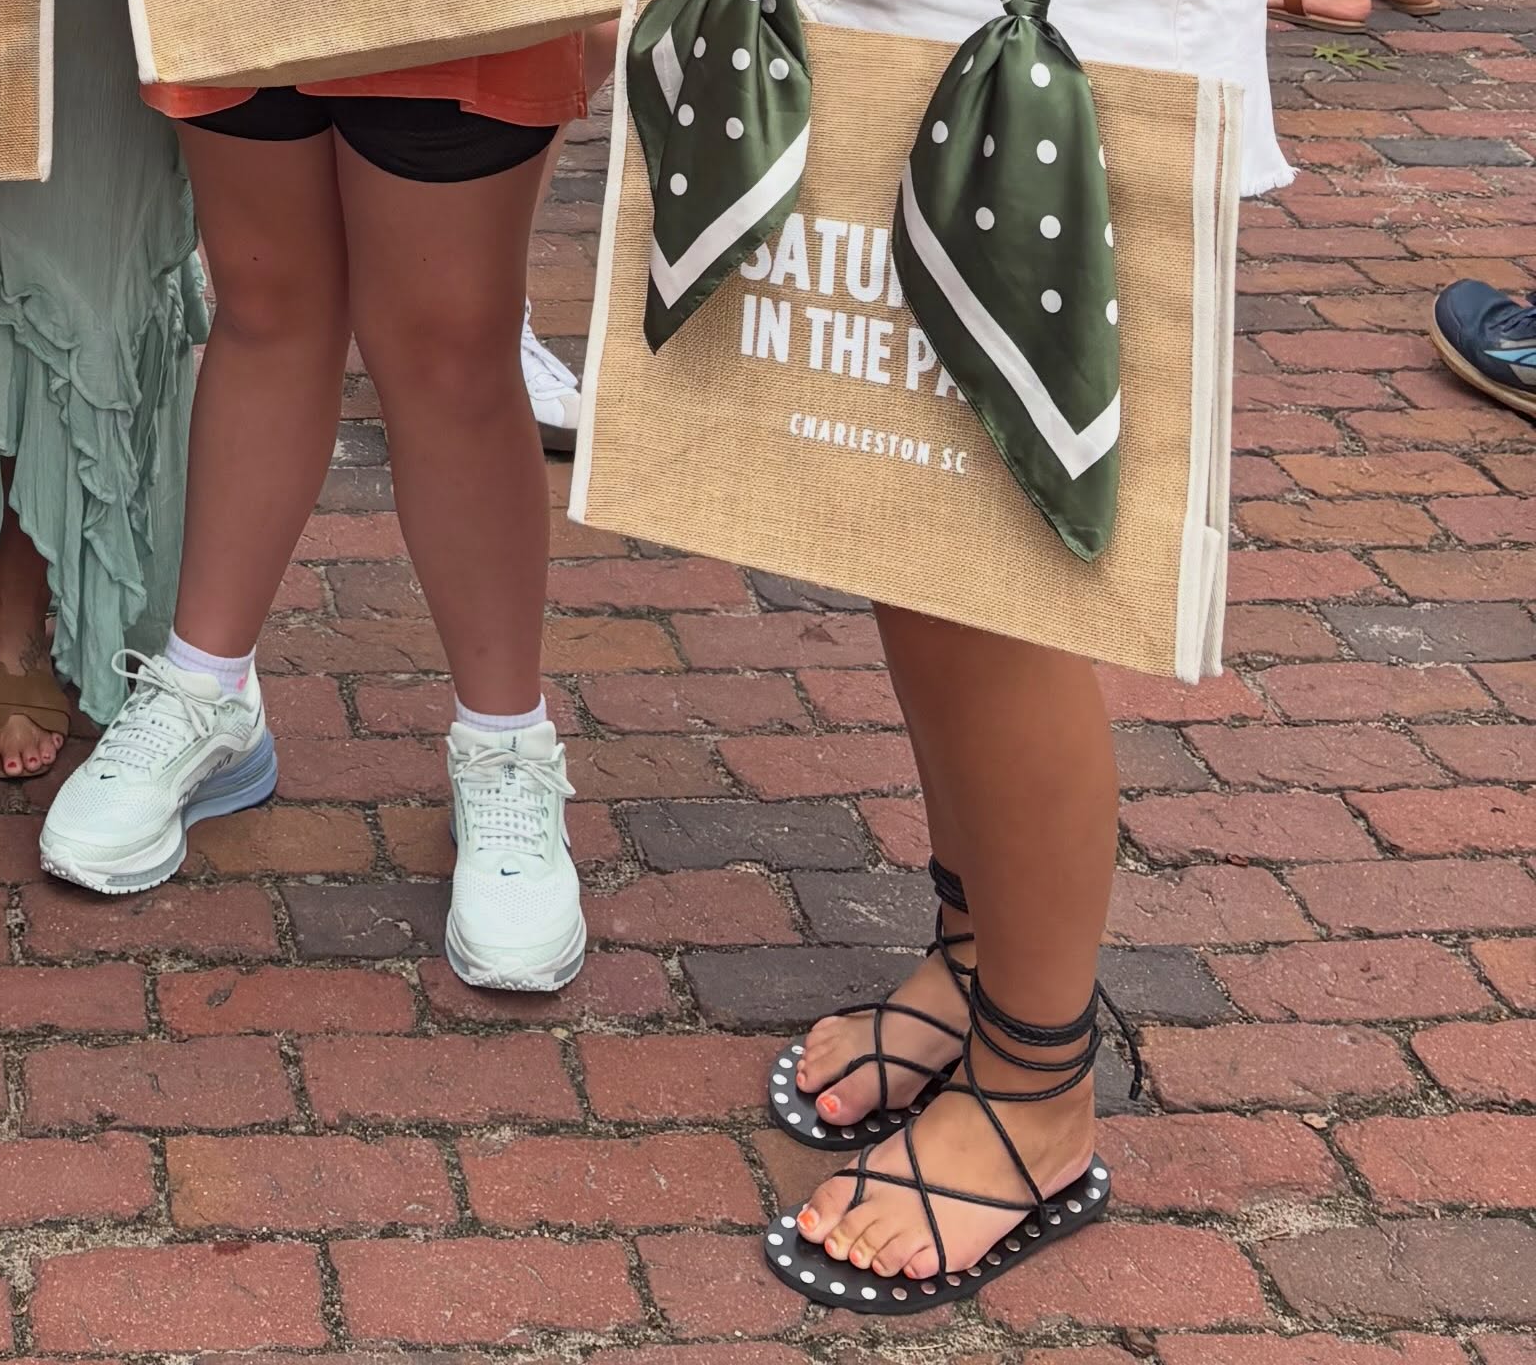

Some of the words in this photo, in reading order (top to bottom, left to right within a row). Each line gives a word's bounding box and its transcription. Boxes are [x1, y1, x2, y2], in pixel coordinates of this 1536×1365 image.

[741, 294, 792, 362] IN
[805, 308, 894, 385] THE
[789, 413, 930, 466] CHARLESTON
[941, 447, 967, 474] SC
